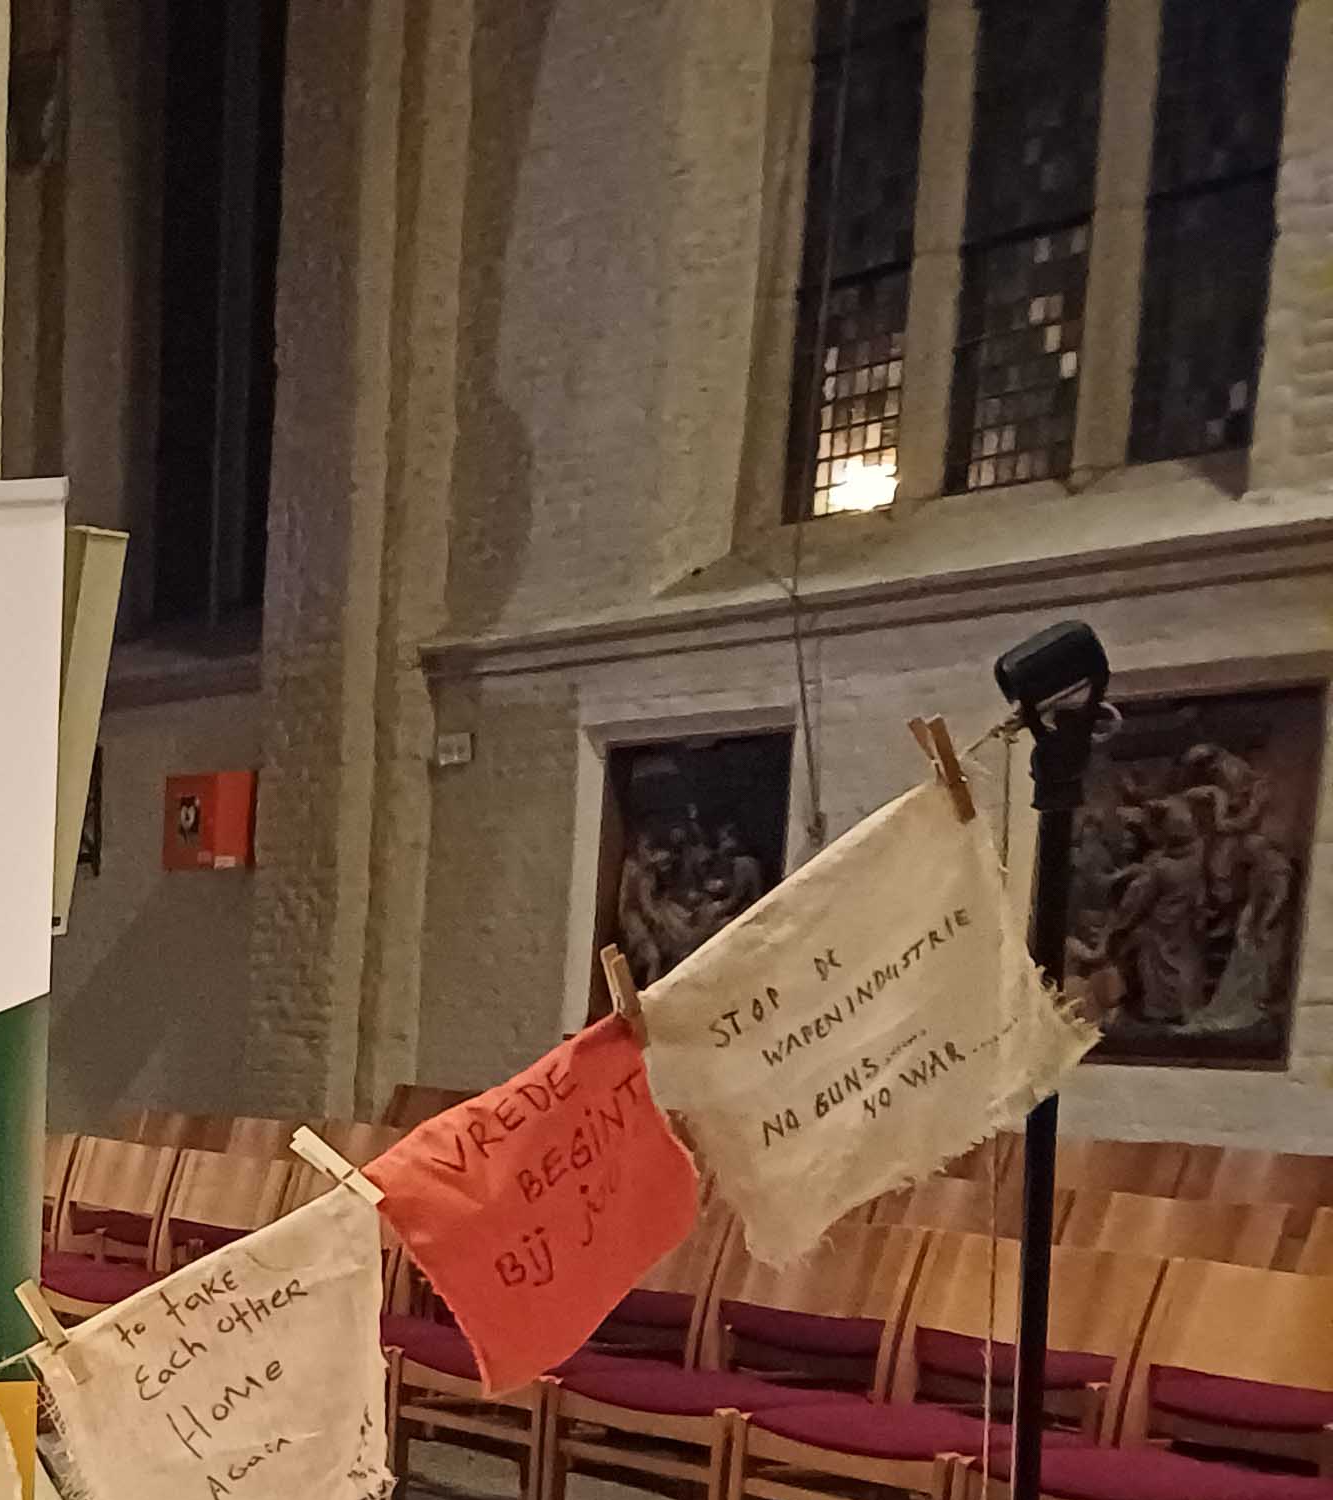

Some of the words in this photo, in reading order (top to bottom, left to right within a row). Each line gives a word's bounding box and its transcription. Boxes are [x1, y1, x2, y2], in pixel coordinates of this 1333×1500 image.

[707, 985, 782, 1049] STOP
[431, 1061, 580, 1176] VREDE
[760, 1107, 802, 1148] NO
[863, 1093, 892, 1120] NO
